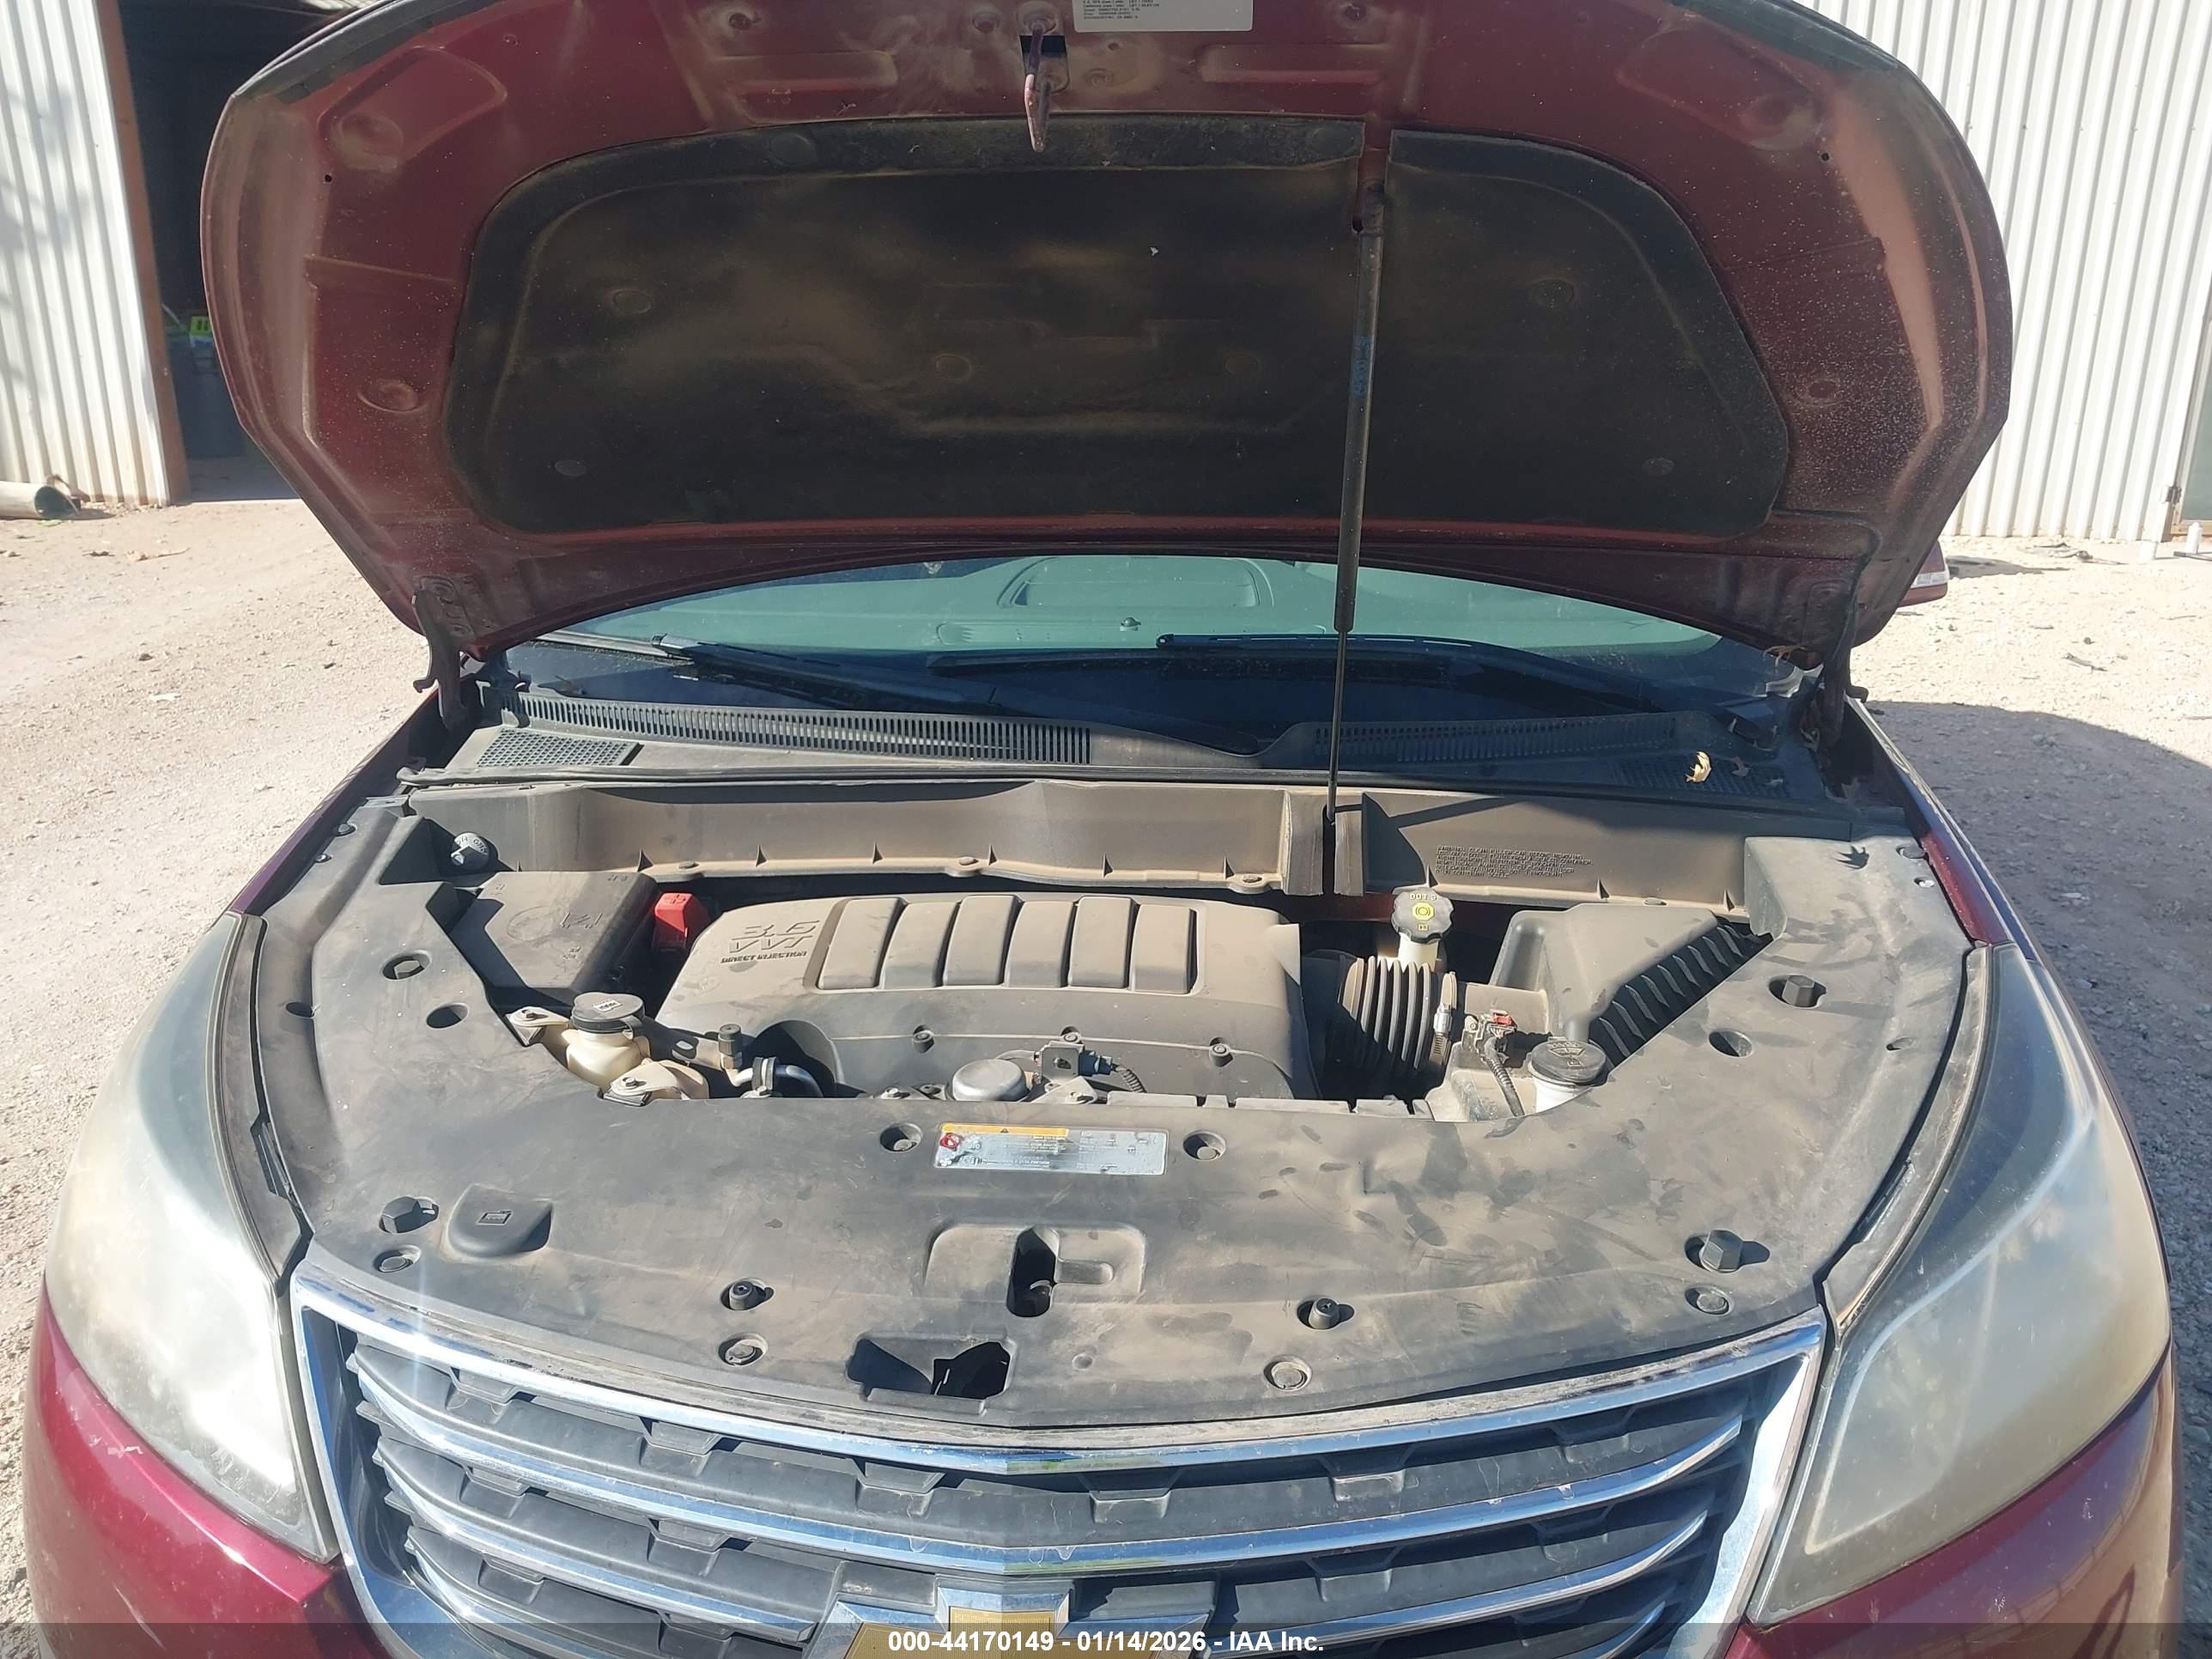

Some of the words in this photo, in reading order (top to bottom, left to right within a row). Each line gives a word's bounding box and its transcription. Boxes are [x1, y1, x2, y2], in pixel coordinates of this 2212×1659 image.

[731, 921, 820, 941] 3.6
[720, 955, 757, 963] DIRECT
[757, 951, 807, 960] INJECTION
